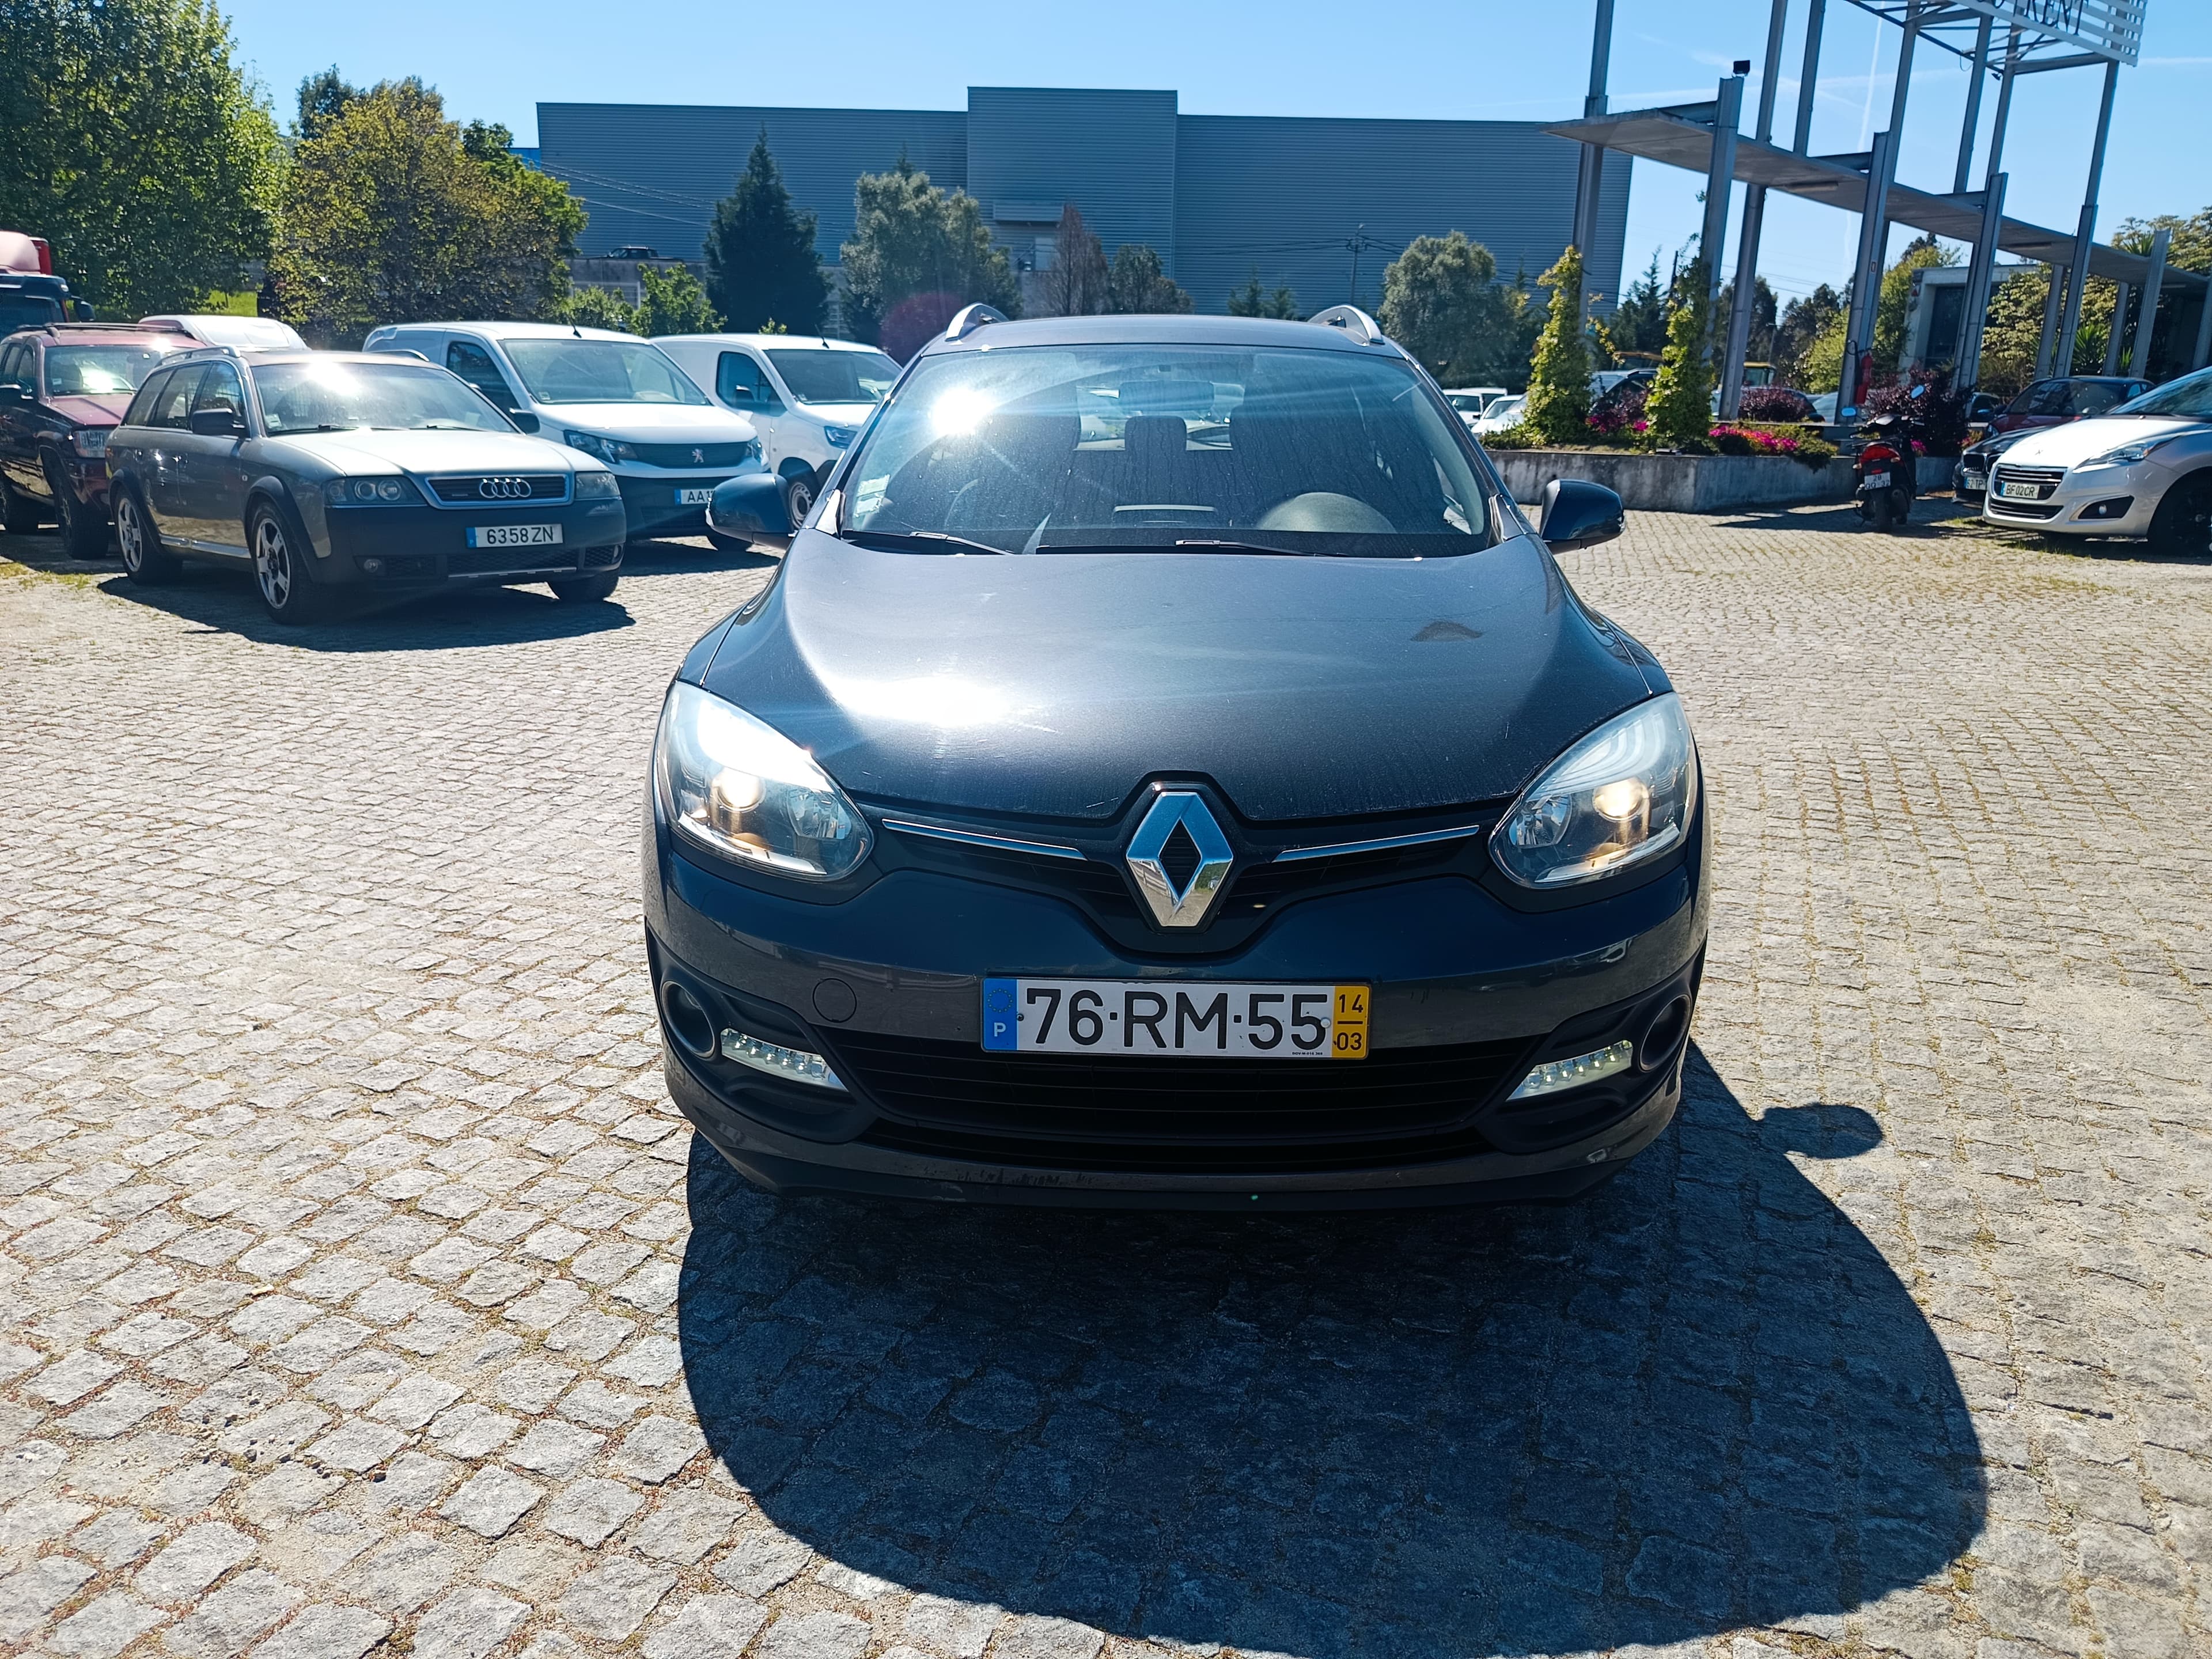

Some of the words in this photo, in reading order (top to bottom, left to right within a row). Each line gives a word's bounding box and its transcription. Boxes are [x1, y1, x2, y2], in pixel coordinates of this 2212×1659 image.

[1339, 994, 1364, 1013] 14
[994, 1022, 1006, 1037] P
[1336, 1032, 1363, 1051] 03
